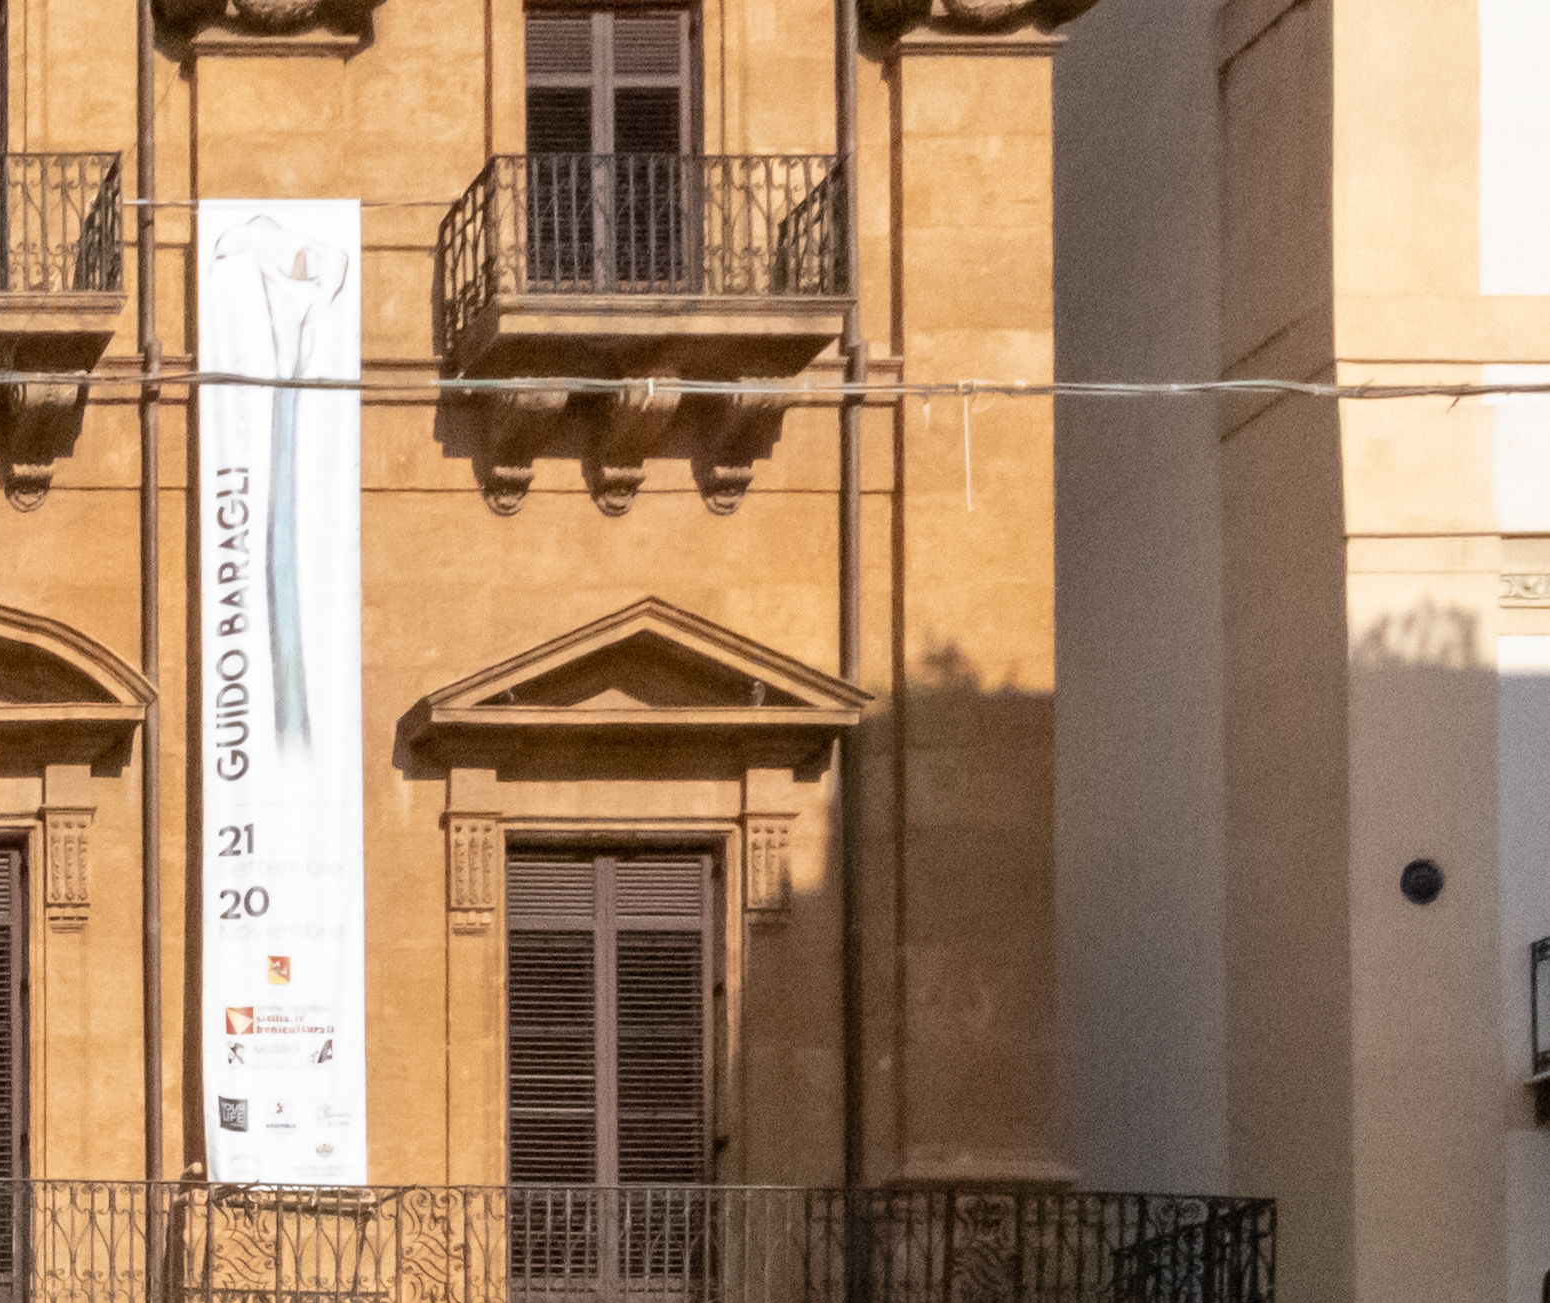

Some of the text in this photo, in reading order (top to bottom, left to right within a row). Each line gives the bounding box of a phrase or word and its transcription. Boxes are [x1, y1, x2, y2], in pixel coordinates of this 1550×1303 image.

[216, 467, 250, 637] BARAGLI
[216, 648, 250, 782] GUIDO
[218, 822, 255, 857] 21
[218, 885, 271, 921] 20
